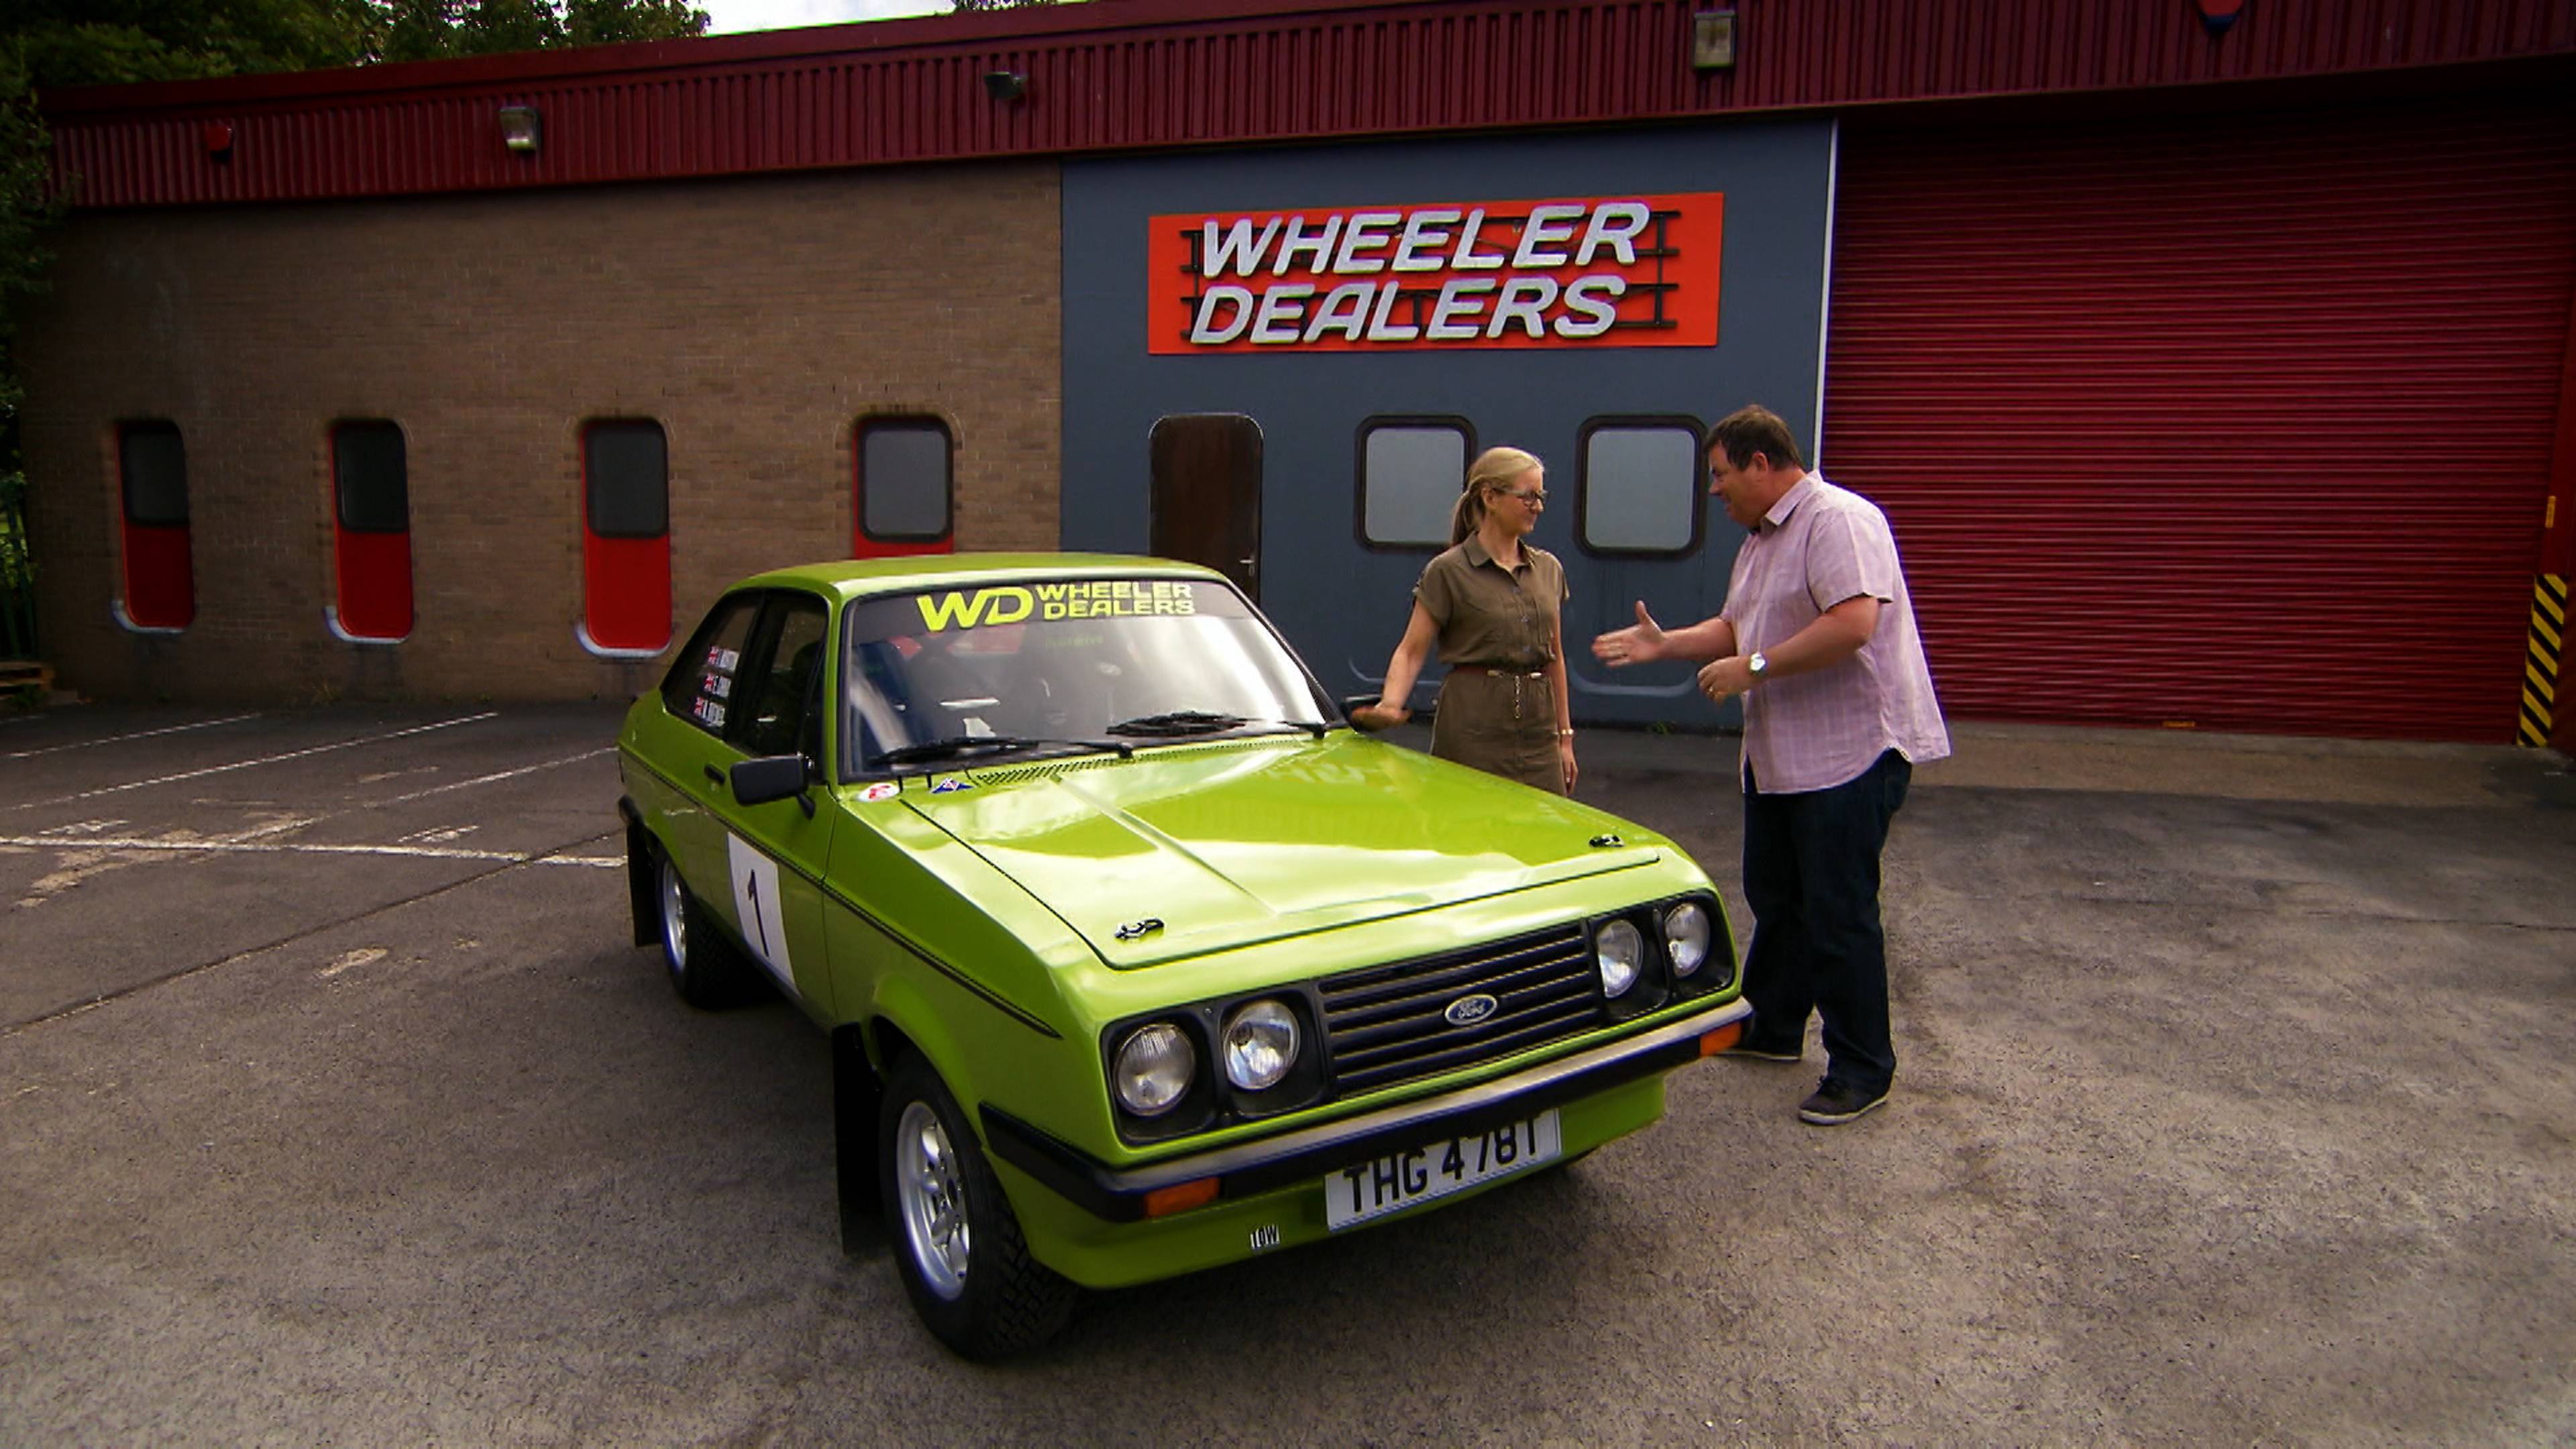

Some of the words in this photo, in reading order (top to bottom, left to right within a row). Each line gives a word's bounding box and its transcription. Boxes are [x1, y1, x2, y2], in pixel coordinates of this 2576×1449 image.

[1203, 203, 1650, 277] WHEELER
[1191, 275, 1626, 344] DEALERS
[917, 587, 1034, 631] WD
[1036, 581, 1192, 600] WHEELER
[1044, 599, 1195, 621] DEALERS
[748, 869, 769, 957] 1
[1344, 1148, 1428, 1212] THG
